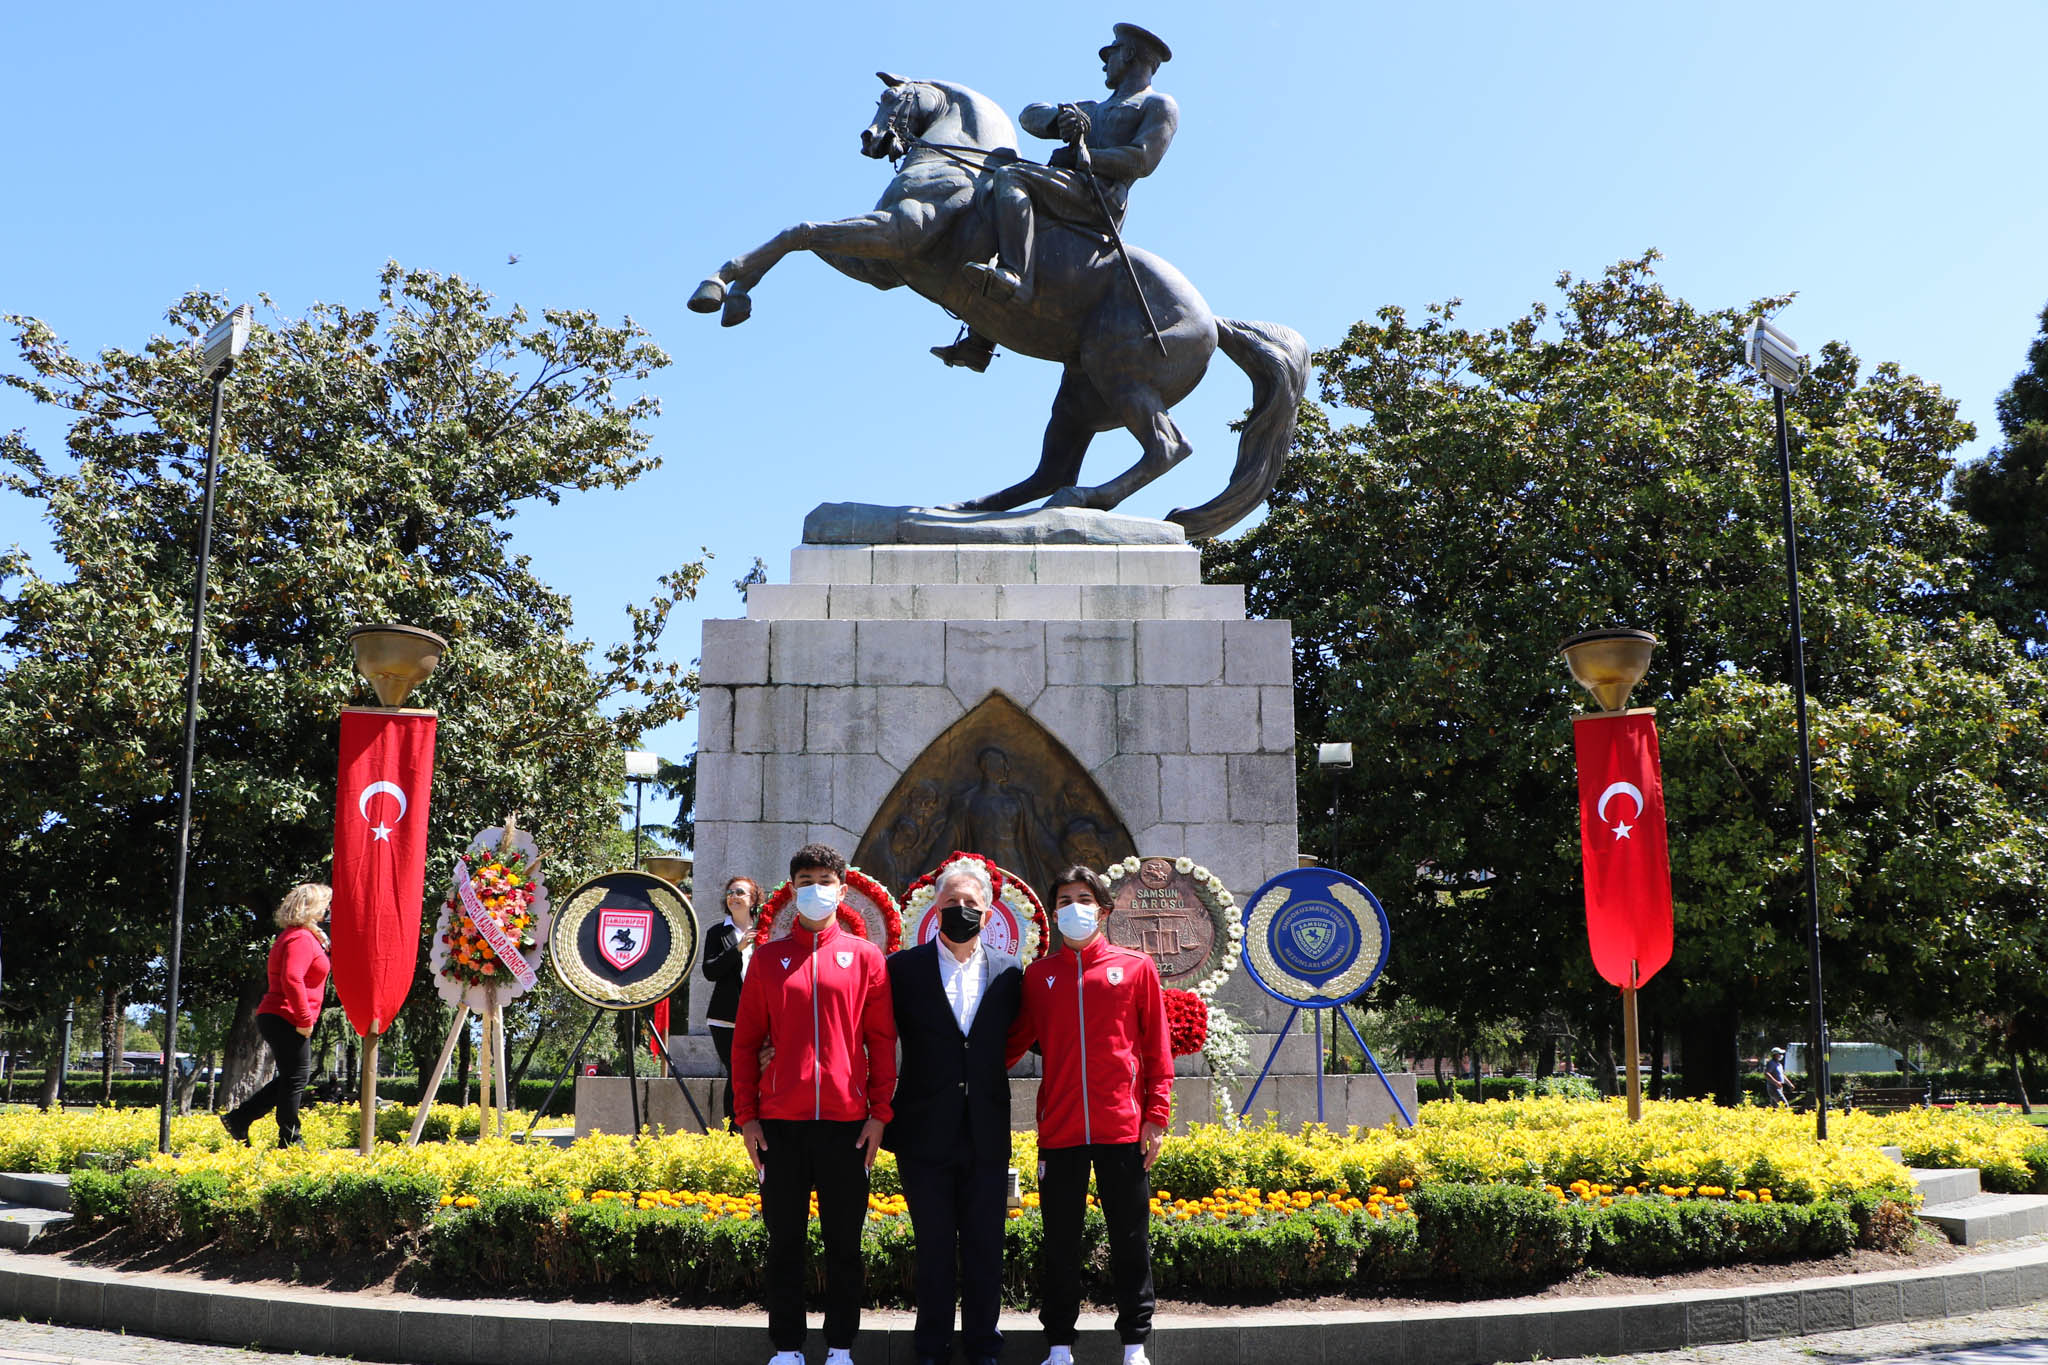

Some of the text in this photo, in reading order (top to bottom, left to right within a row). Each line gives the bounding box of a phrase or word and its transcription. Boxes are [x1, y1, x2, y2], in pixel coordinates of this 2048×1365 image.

[1136, 888, 1178, 898] SAMSUN
[1131, 899, 1185, 909] BAROSU
[475, 915, 507, 951] KADINLAR
[1157, 962, 1175, 972] 923
